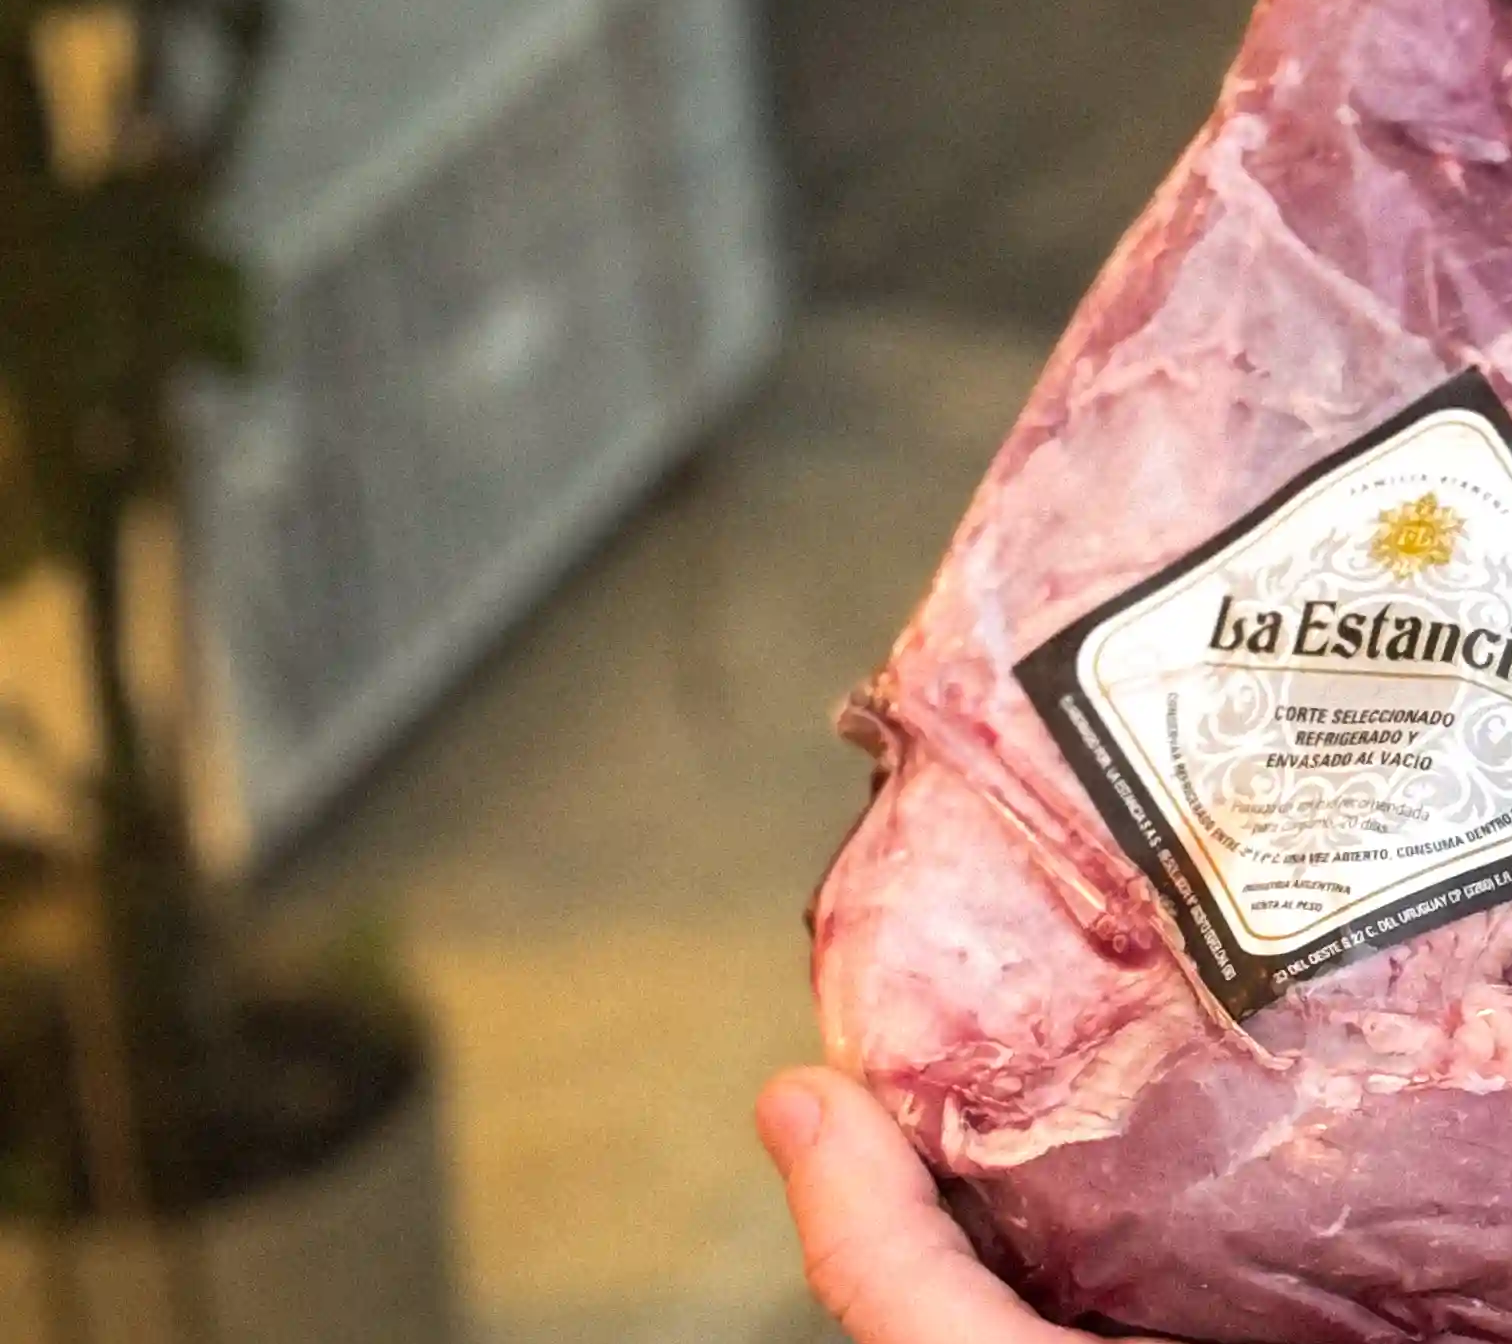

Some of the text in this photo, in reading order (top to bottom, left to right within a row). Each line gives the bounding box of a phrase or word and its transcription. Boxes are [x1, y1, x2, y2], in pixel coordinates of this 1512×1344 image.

[1208, 595, 1284, 654] La
[1274, 705, 1455, 728] CORTE SELECCIONADO
[1295, 730, 1419, 747] REFRIGERADO Y
[1266, 752, 1352, 769] ENVASADO
[1353, 751, 1374, 765] AL
[1396, 836, 1465, 858] CONSUMA
[1465, 814, 1512, 843] DENTRO
[1287, 959, 1312, 976] DEL
[1308, 940, 1344, 965] OESTE
[1377, 916, 1400, 933] DEL
[1397, 895, 1449, 924] URUGUAY
